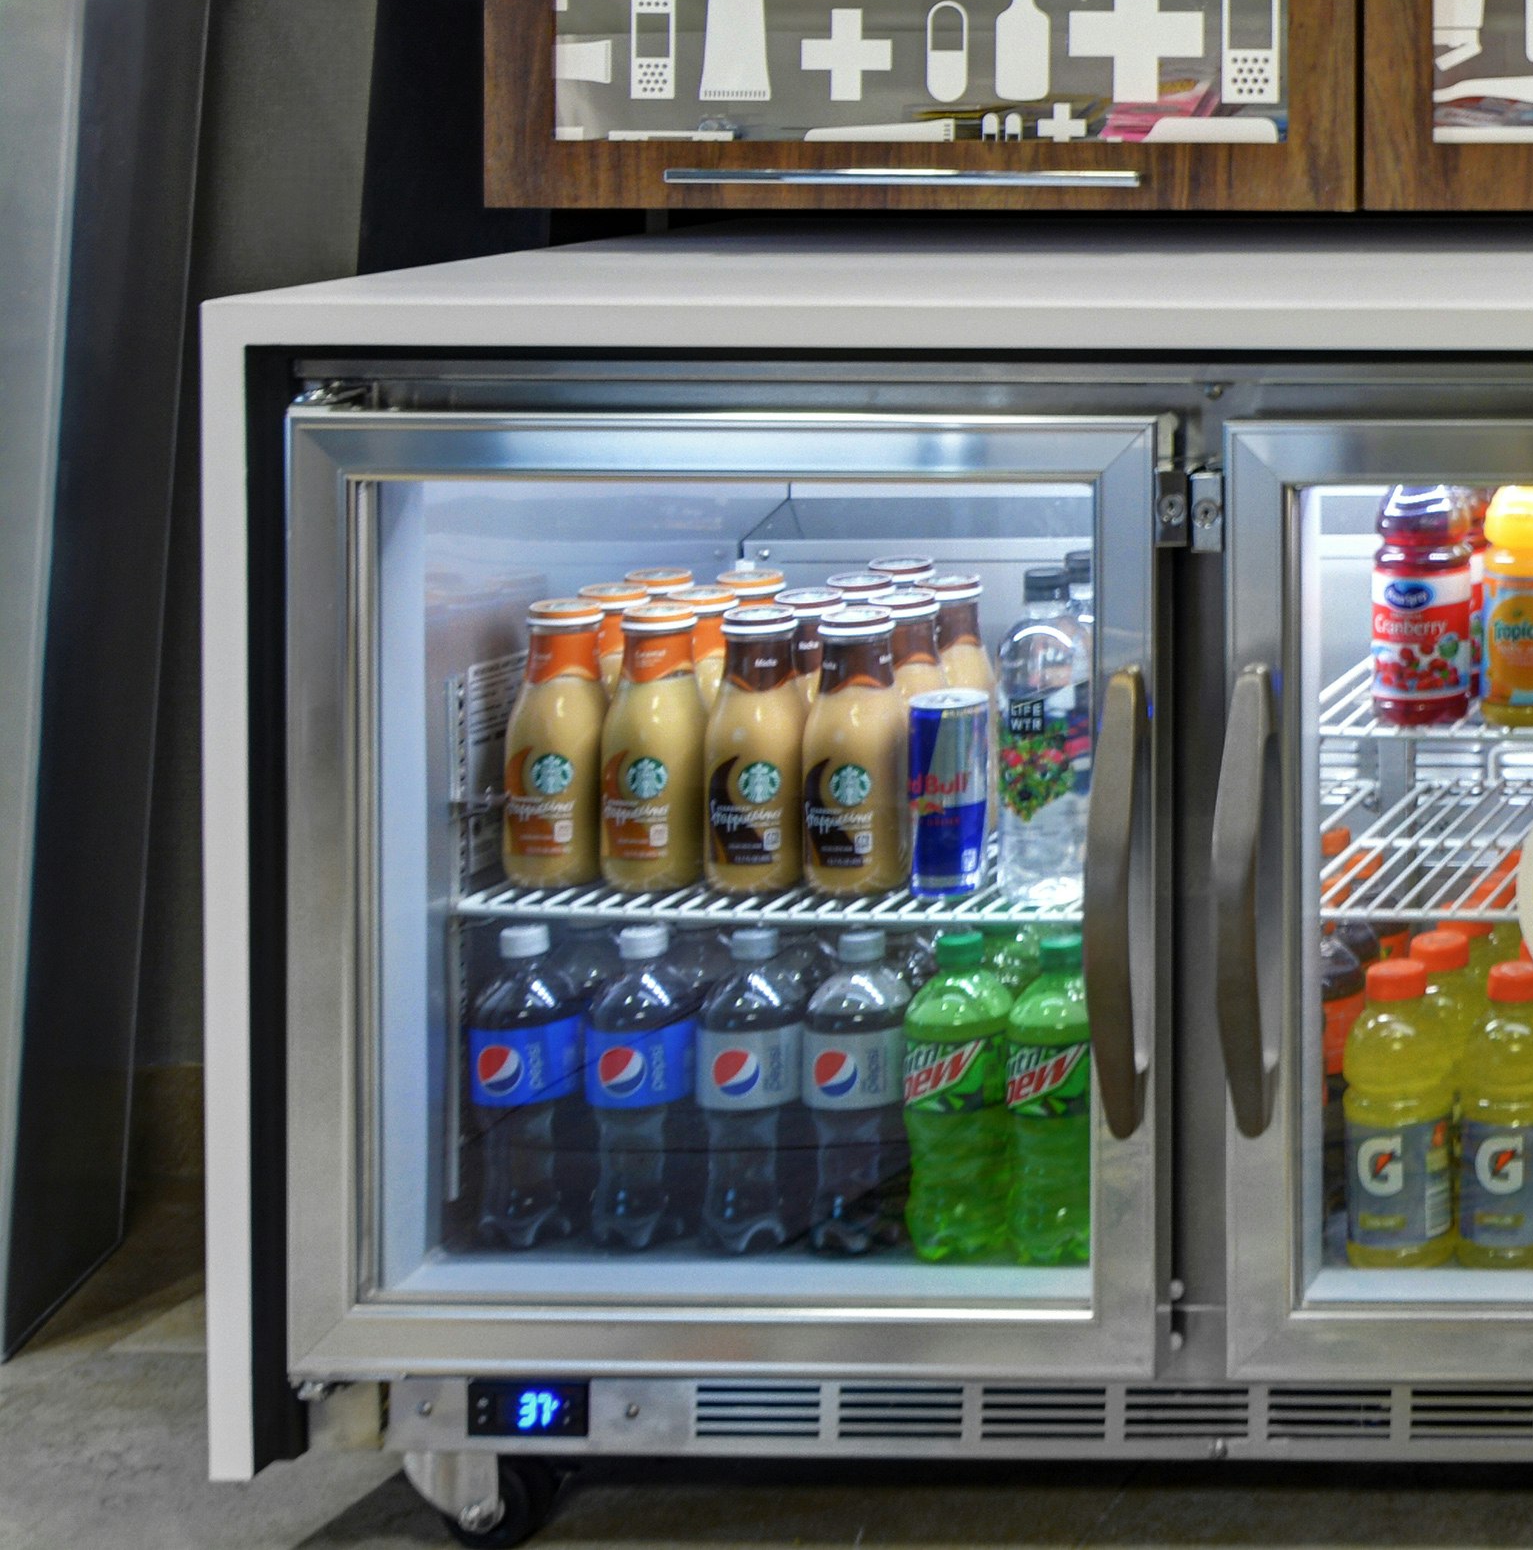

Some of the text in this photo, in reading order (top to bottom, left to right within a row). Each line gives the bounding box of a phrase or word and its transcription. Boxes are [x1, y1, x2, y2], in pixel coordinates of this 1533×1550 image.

[1374, 613, 1448, 637] Cranberry
[1010, 701, 1044, 718] LIFE
[1010, 718, 1044, 732] WTR
[926, 771, 970, 796] Bull
[1357, 1134, 1404, 1197] G
[1475, 1136, 1525, 1196] G
